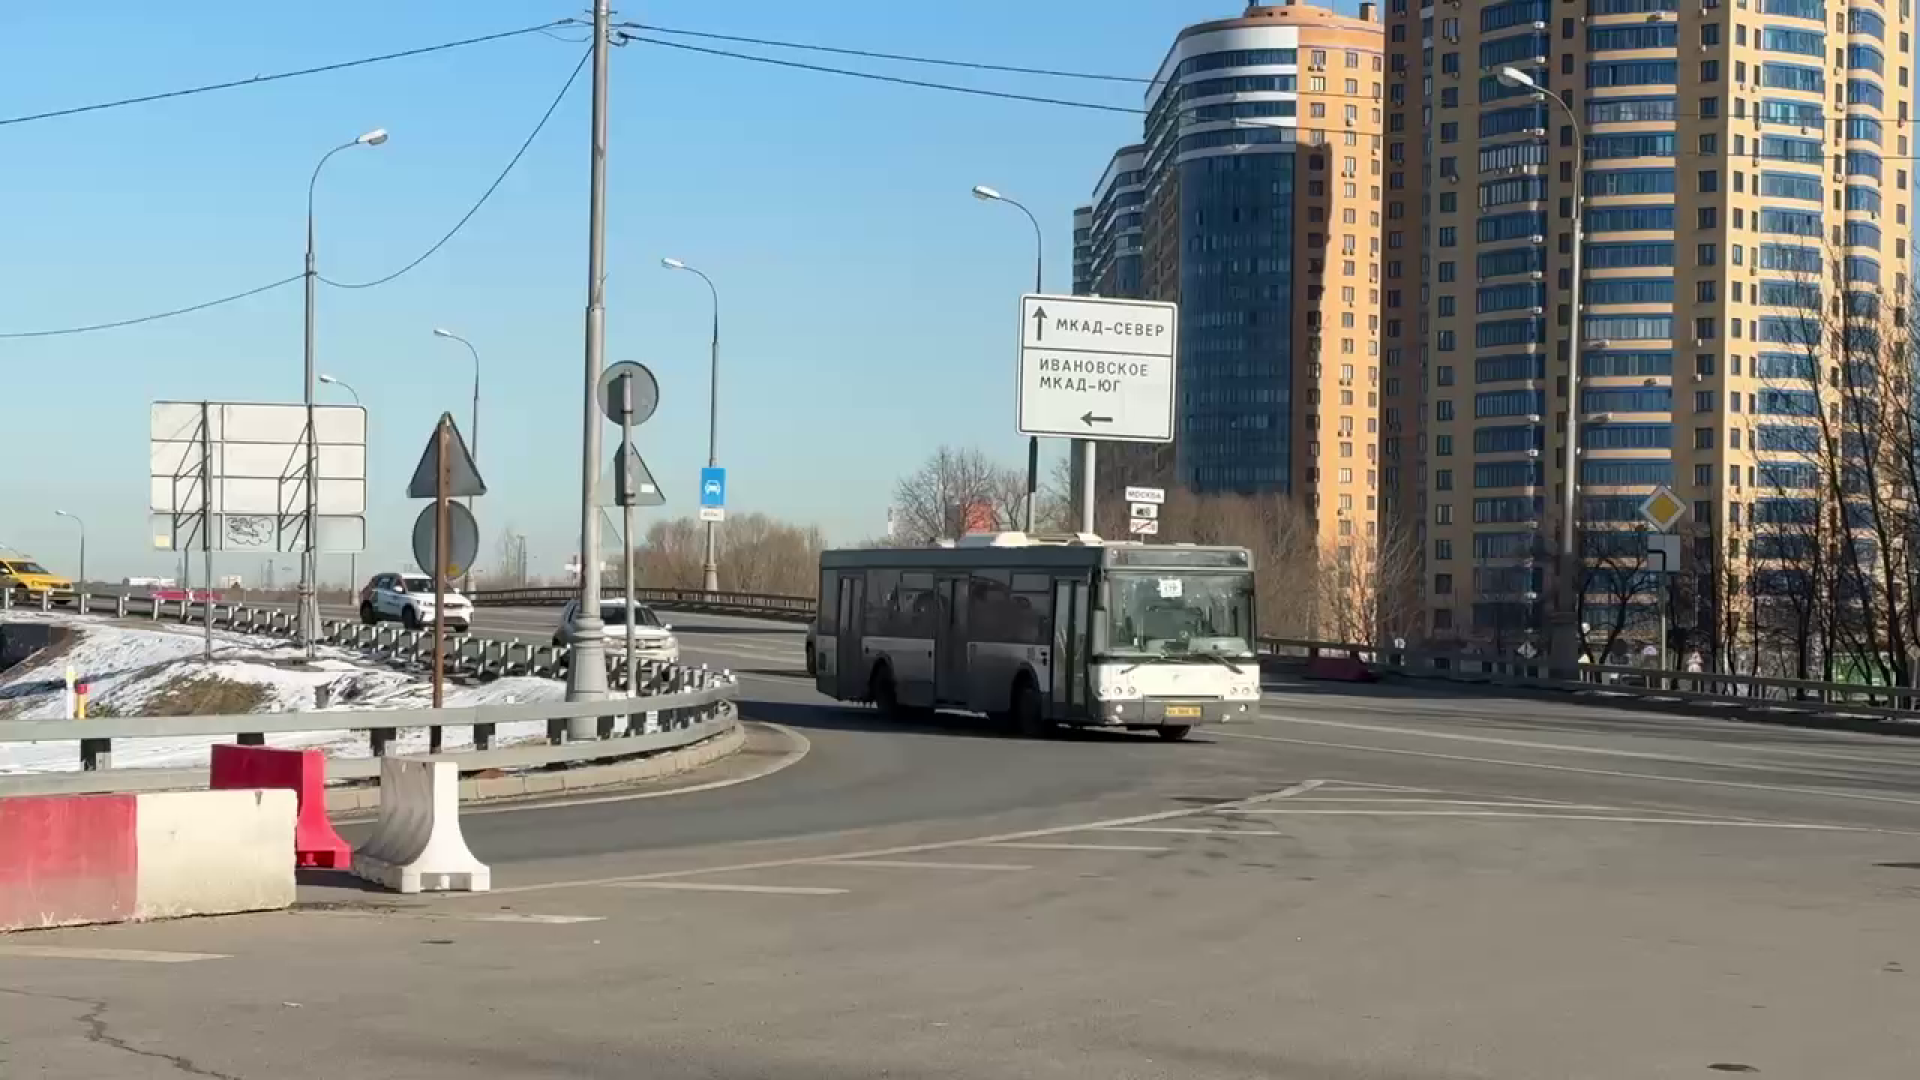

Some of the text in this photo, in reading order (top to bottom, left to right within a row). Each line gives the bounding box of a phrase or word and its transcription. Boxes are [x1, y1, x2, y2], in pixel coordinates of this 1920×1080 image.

[1056, 318, 1165, 337] МКАД-СЕВЕР
[1039, 358, 1149, 377] ИВАНОВСКОЕ
[1039, 376, 1121, 392] МКАД-ЮГ
